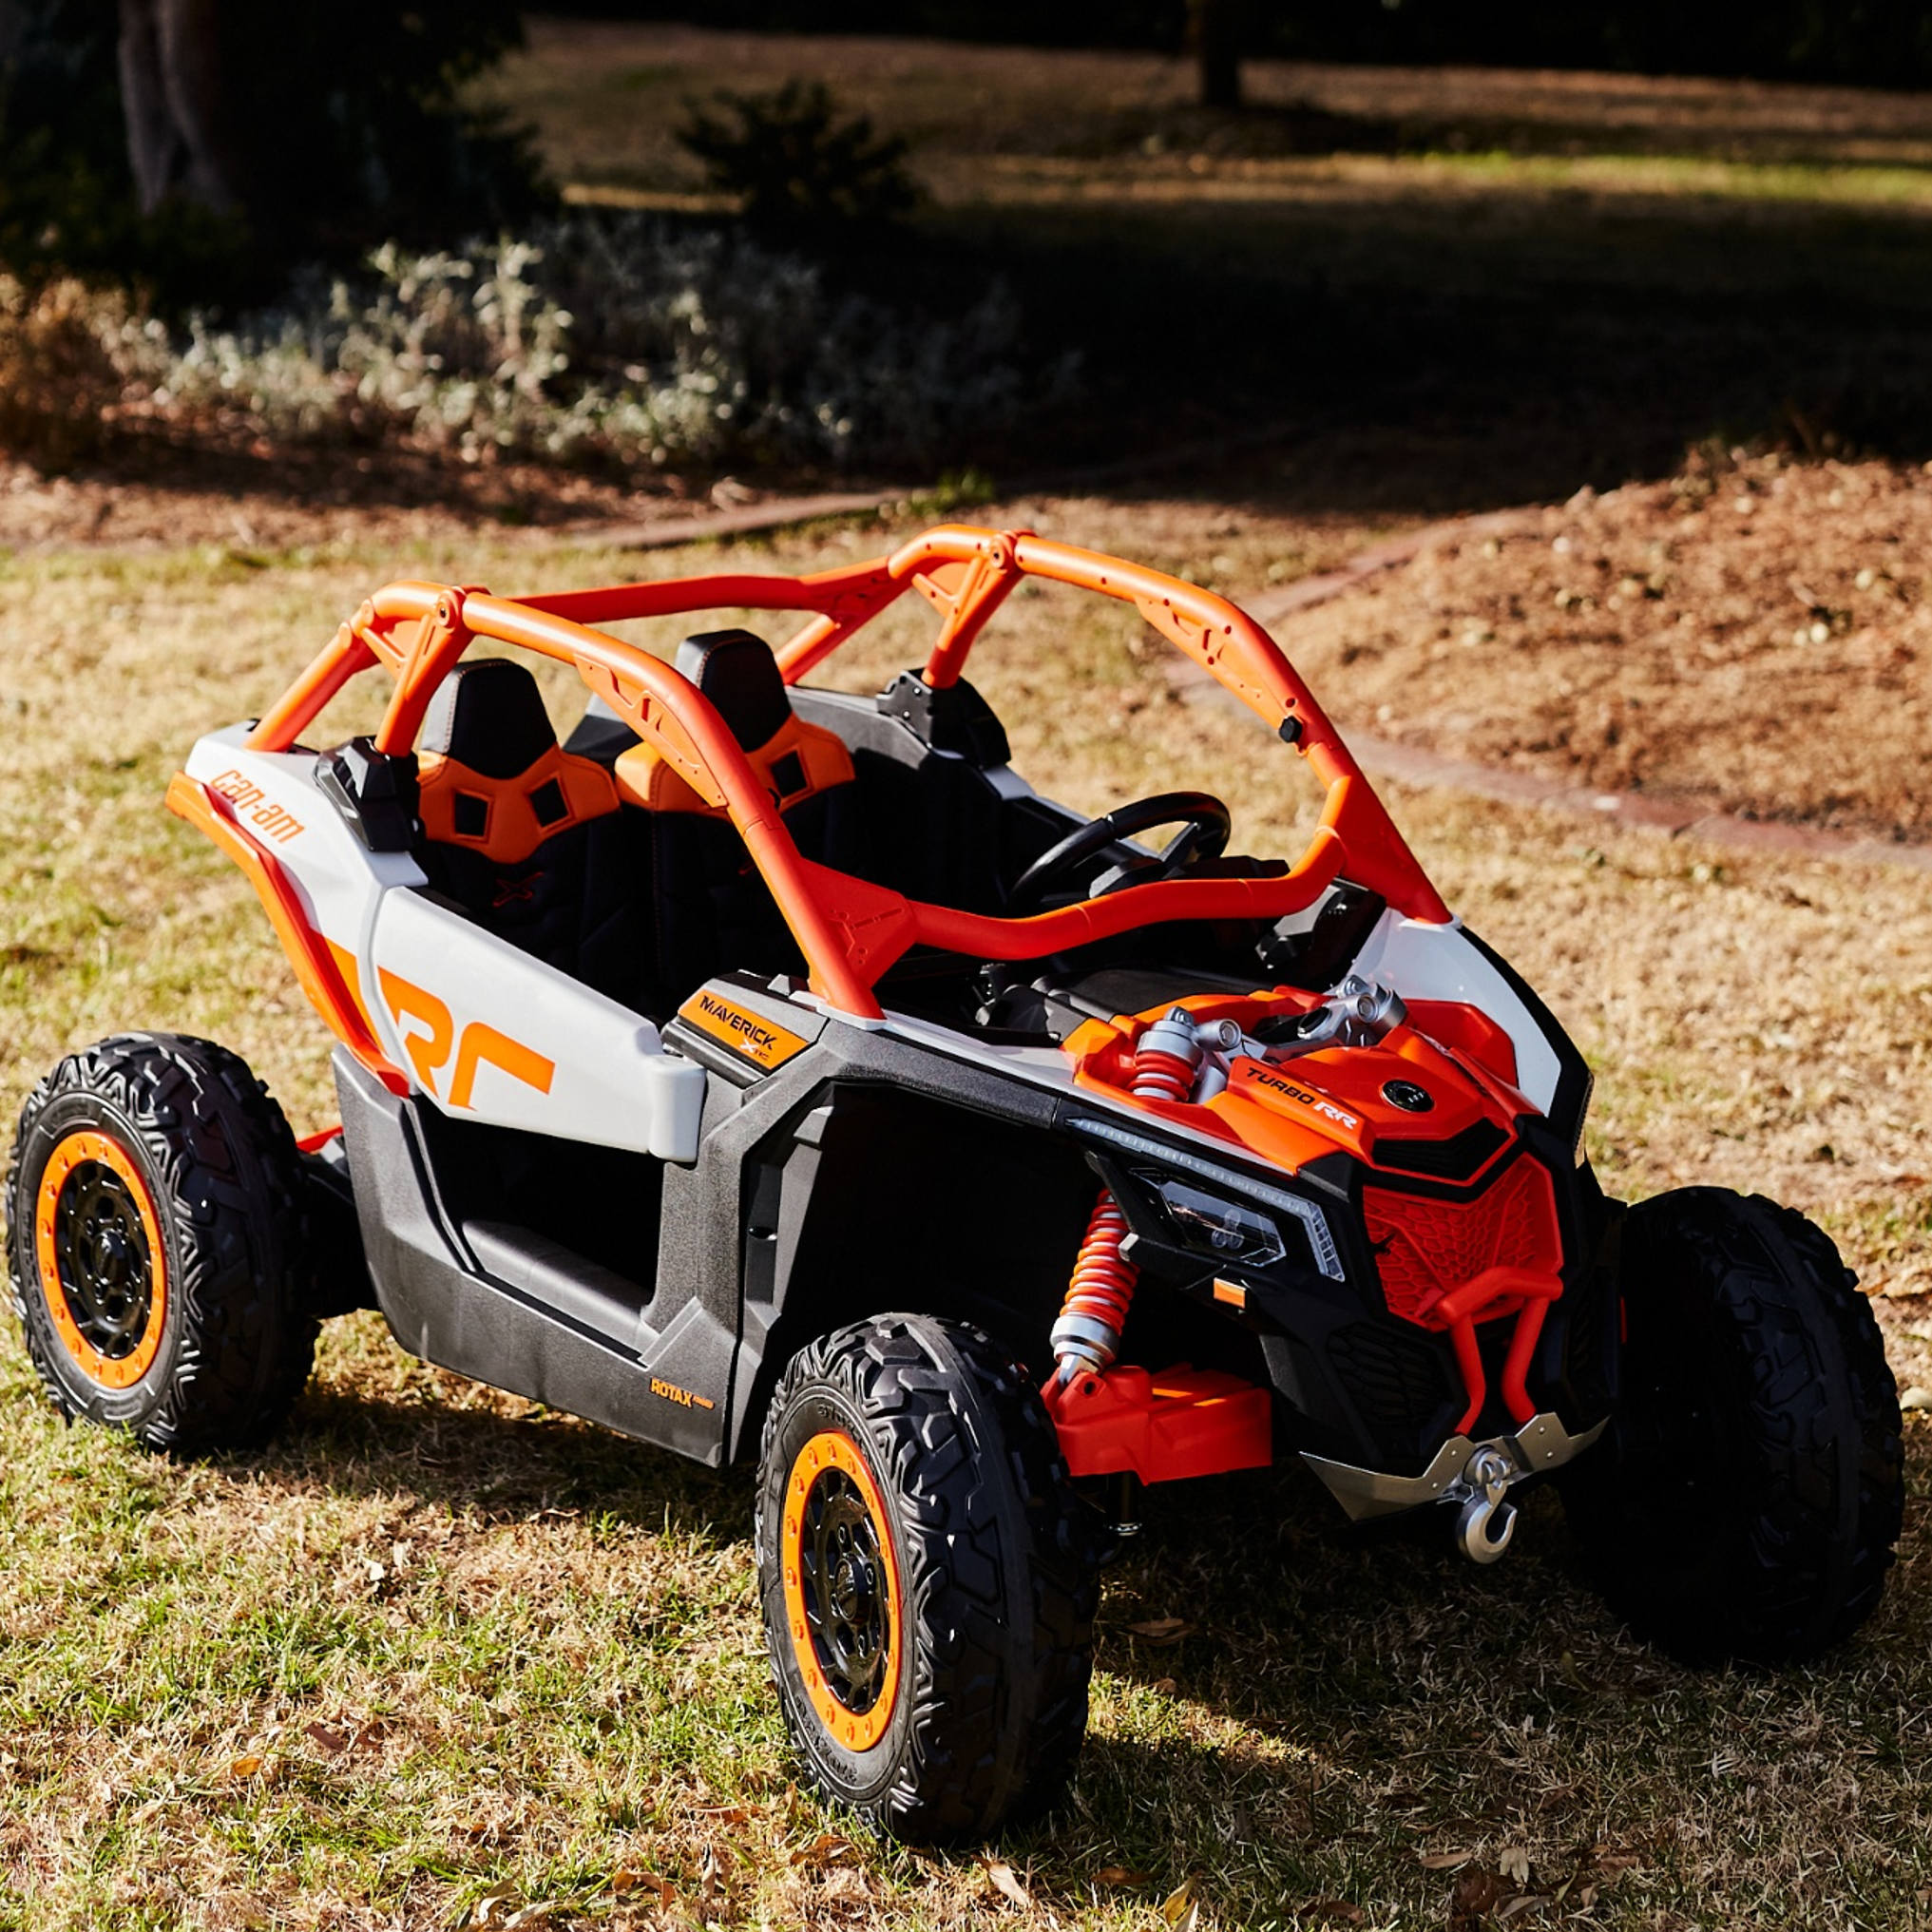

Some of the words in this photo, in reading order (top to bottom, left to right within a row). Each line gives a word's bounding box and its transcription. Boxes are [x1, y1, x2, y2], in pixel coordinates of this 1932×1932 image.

[699, 995, 777, 1051] MAVERICK
[1246, 1066, 1316, 1105] TURBO
[1312, 1100, 1359, 1130] RR
[650, 1376, 693, 1408] ROTAX
